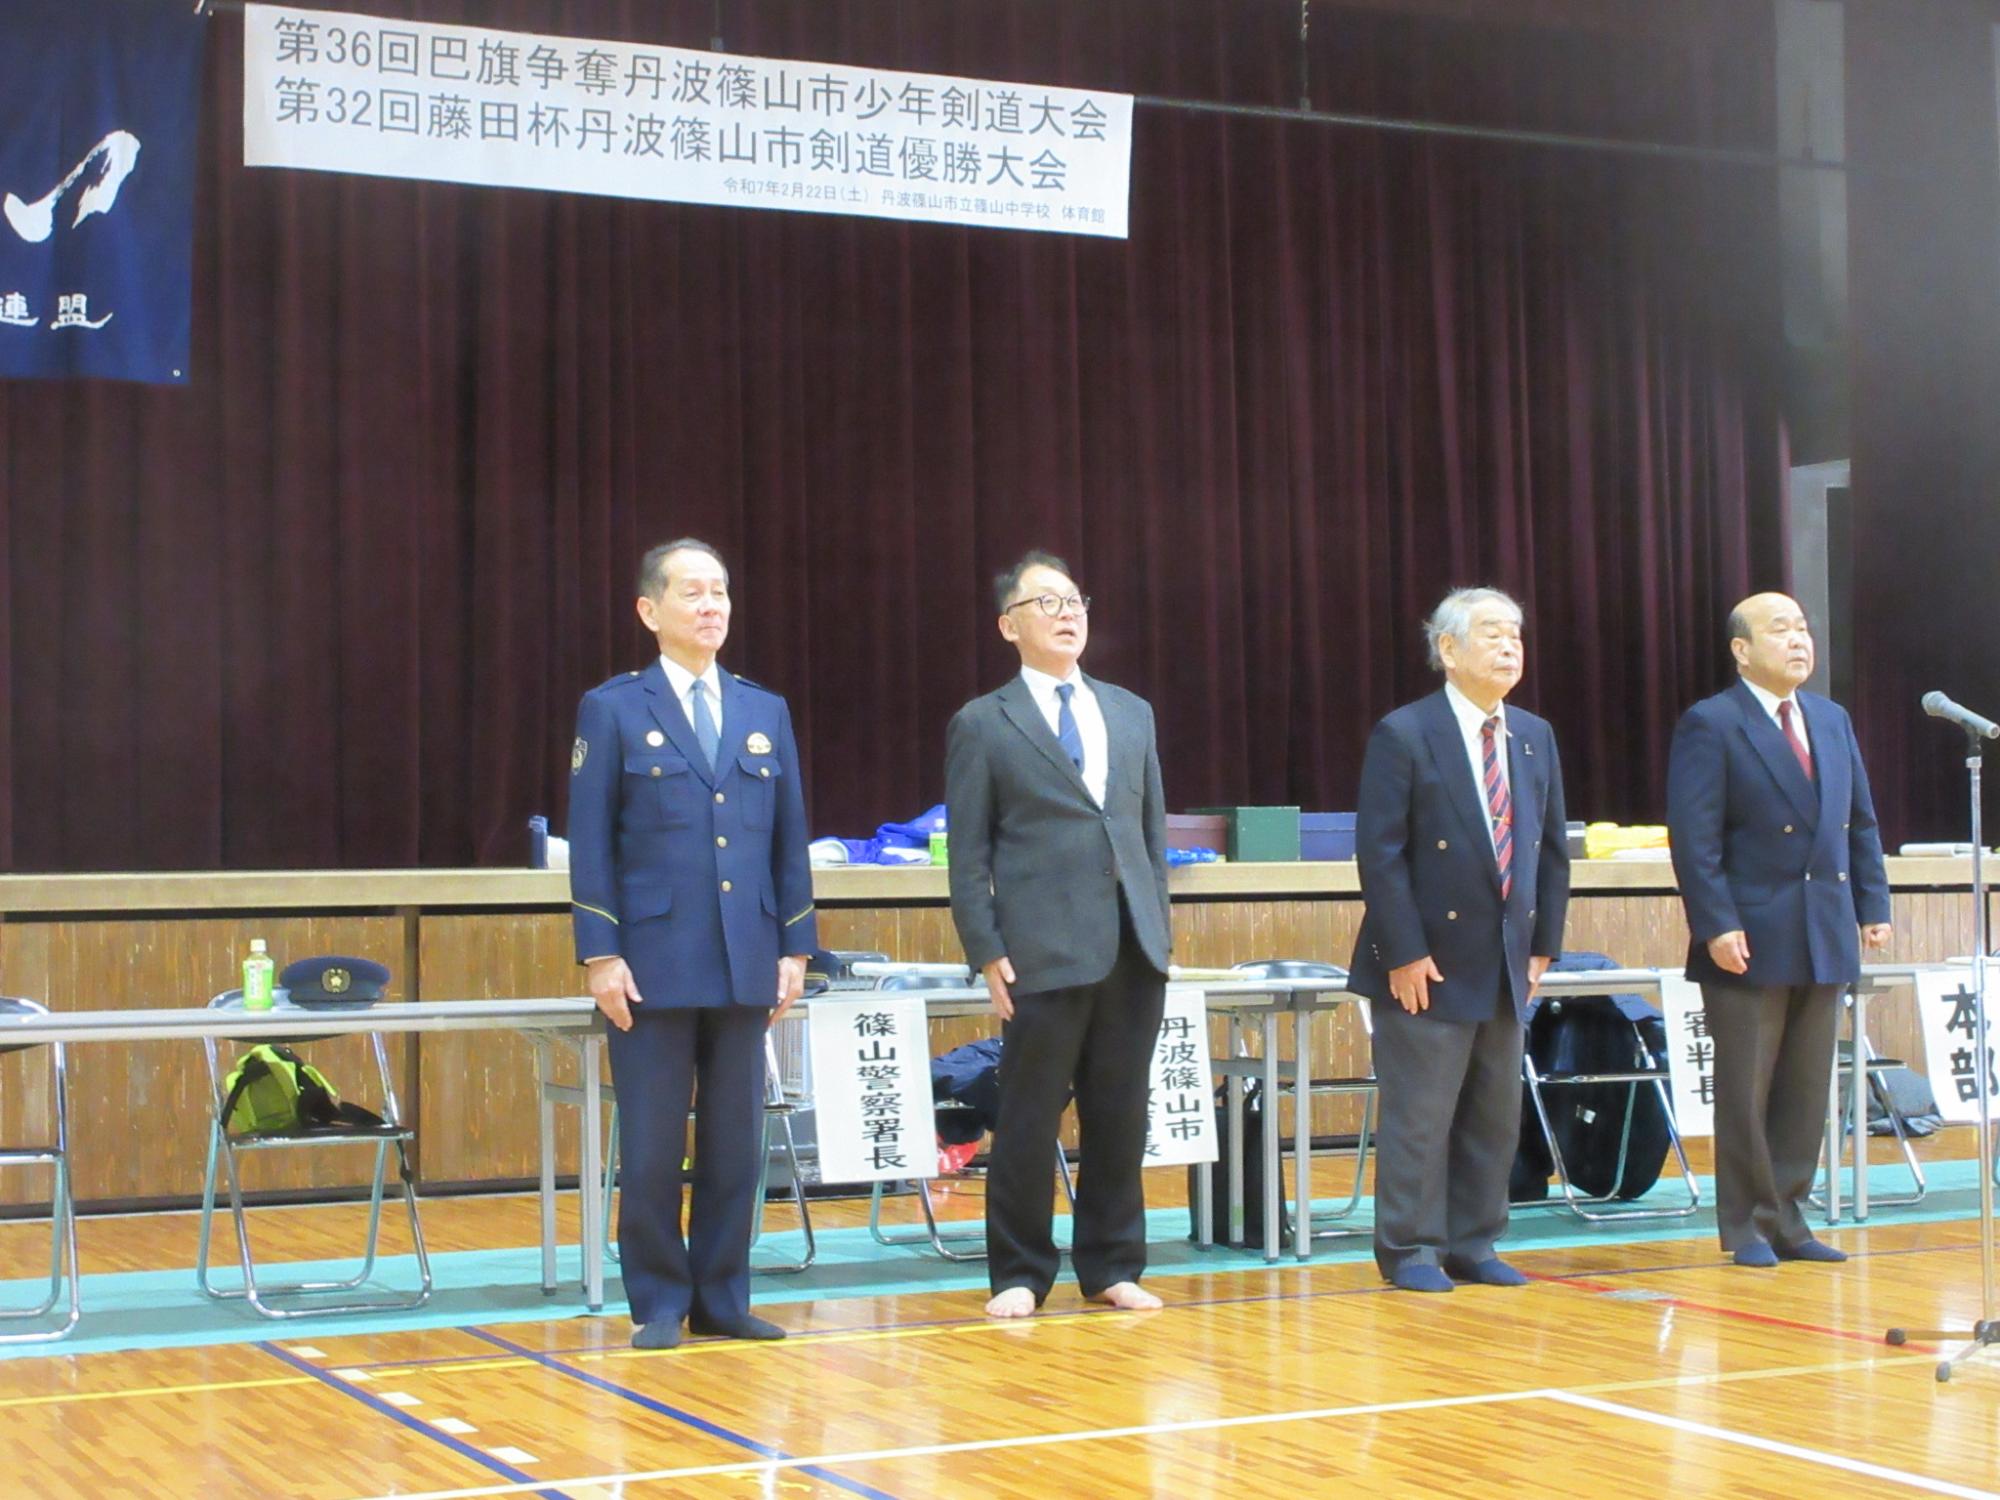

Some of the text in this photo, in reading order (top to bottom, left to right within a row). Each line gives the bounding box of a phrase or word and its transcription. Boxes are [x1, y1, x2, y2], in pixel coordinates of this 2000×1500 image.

[274, 16, 1108, 142] 第36回巴旗争奪丹波篠山市少年剣道大会
[274, 75, 1068, 191] 第32回藤田杯丹波篠山市剣道優勝大会
[881, 189, 1050, 220] 丹波篠山市立篠山中学校
[1061, 205, 1105, 224] 体育館
[853, 1011, 908, 1170] 篠山警察署長
[1157, 1015, 1204, 1141] 丹波篠山市
